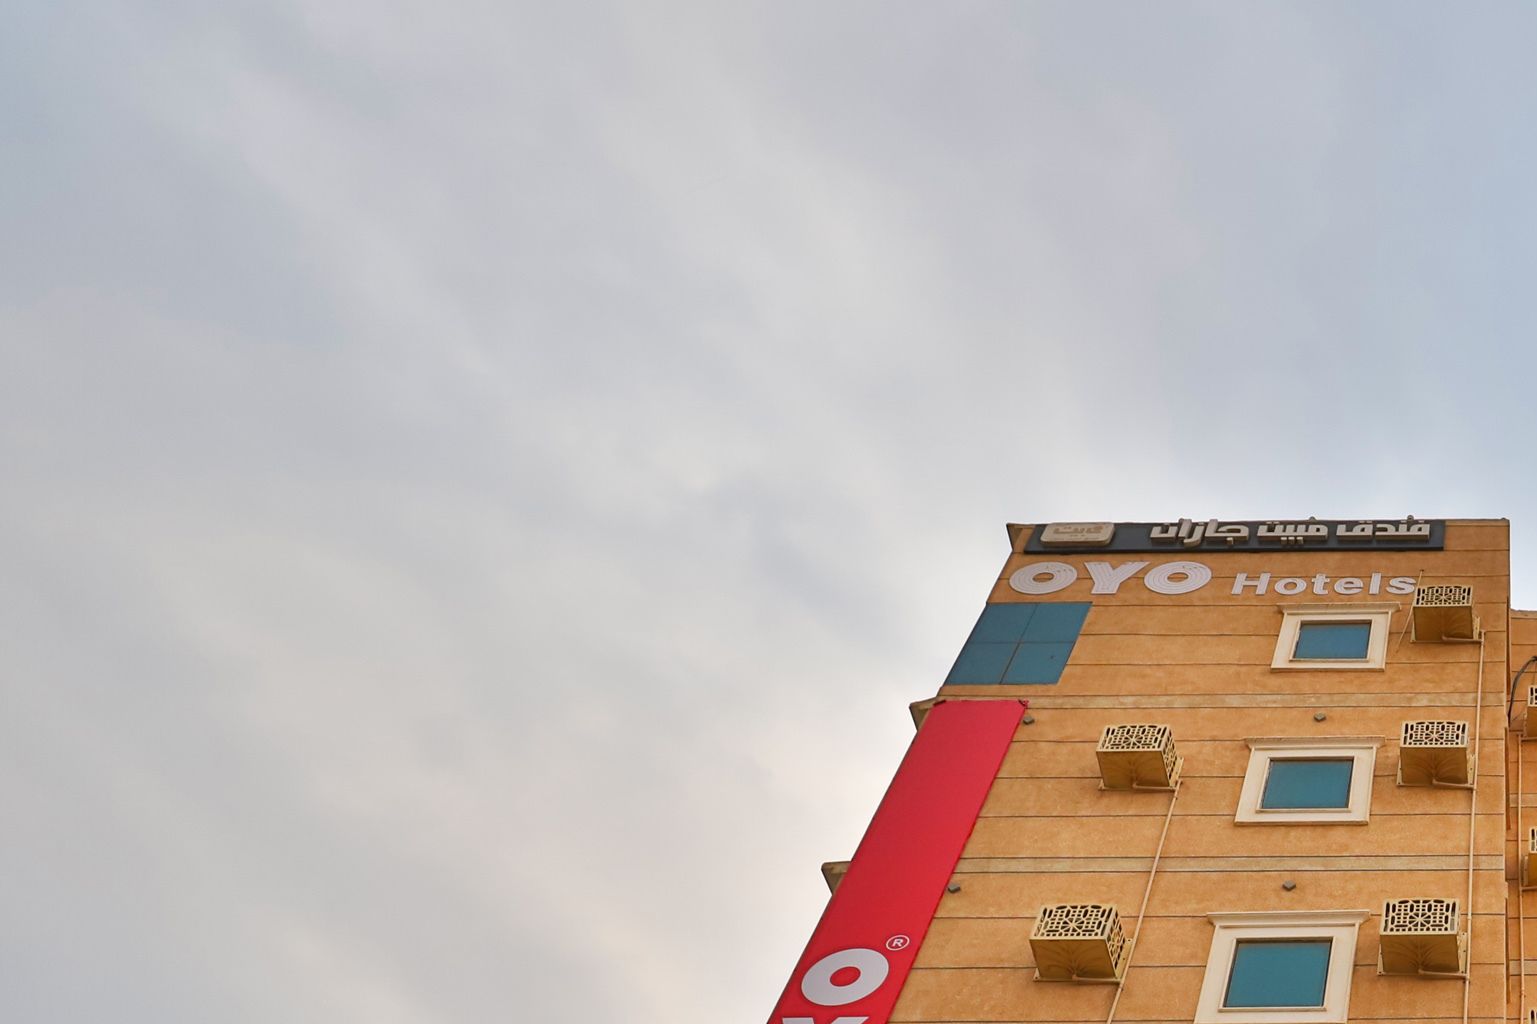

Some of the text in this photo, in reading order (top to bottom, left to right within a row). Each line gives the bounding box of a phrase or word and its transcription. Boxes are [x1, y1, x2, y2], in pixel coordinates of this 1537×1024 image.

[1150, 518, 1430, 547] فندق مبيت جازان
[1008, 561, 1417, 595] OYO Hotels
